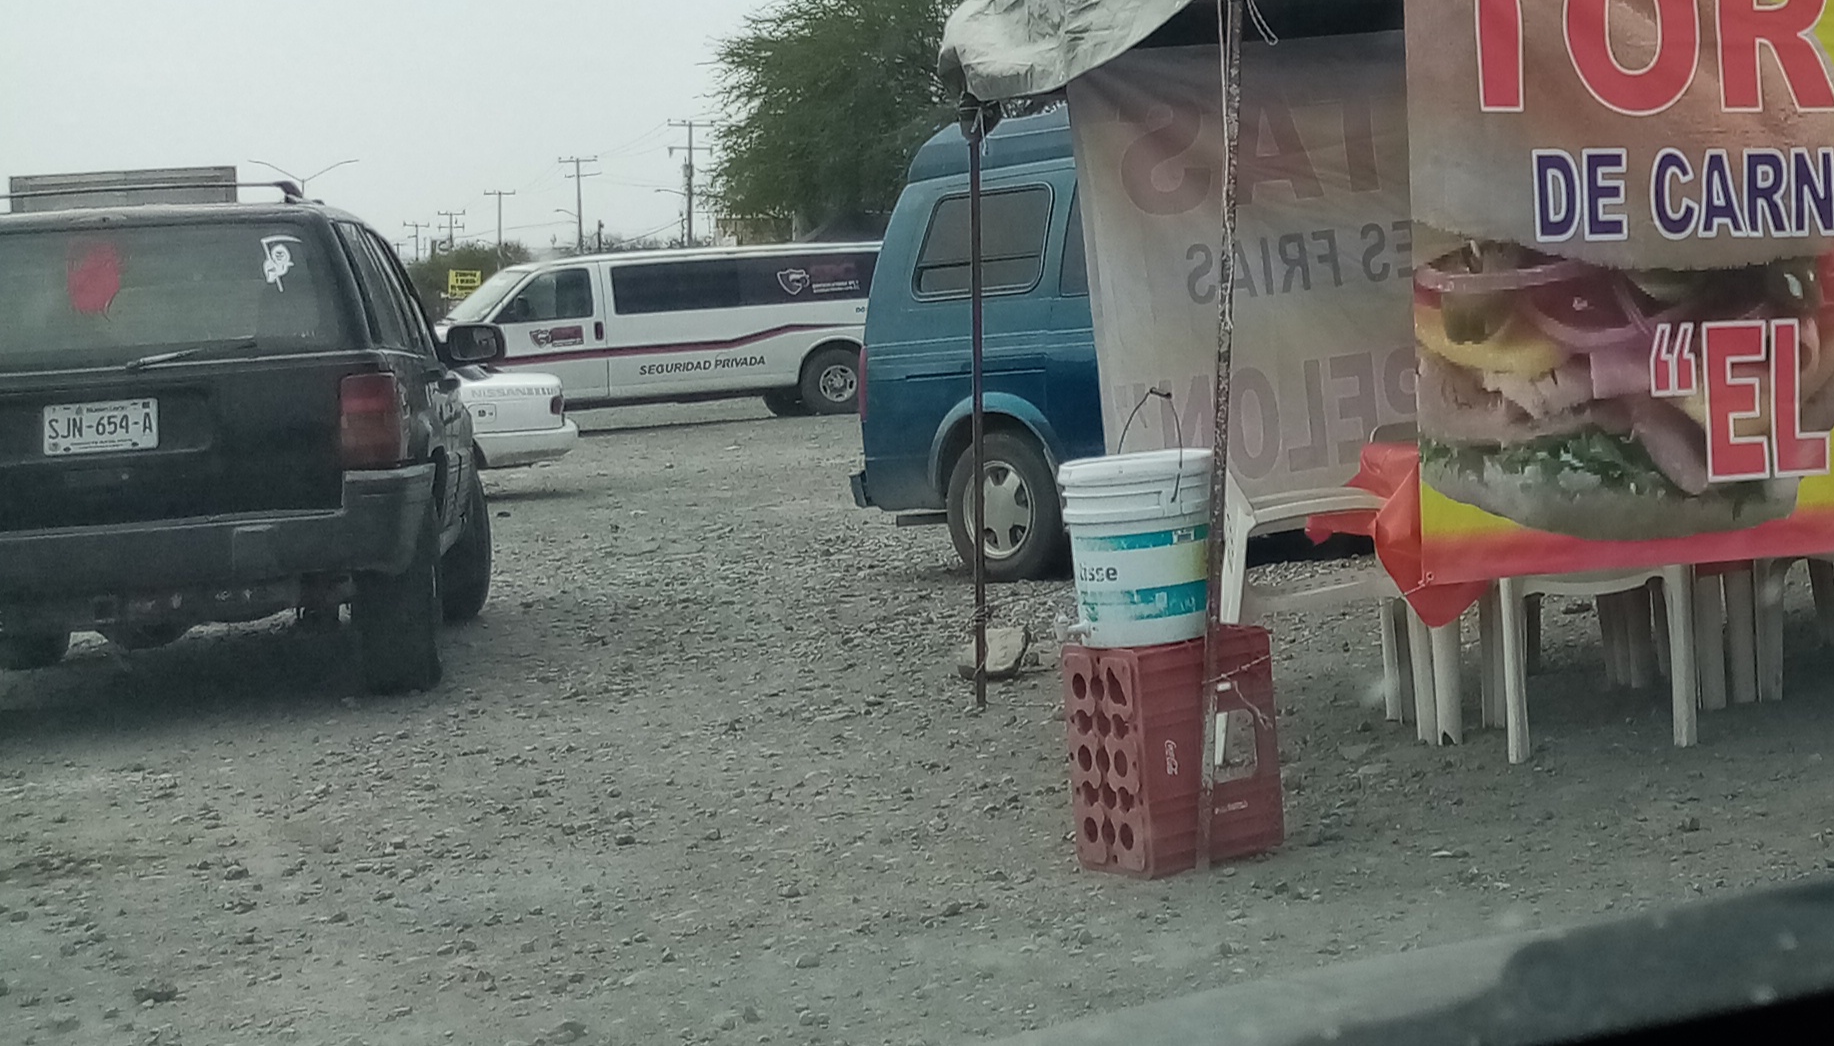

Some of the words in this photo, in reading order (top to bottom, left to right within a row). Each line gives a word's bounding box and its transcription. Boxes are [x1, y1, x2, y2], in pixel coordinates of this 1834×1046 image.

[1531, 148, 1628, 242] DE
[639, 359, 711, 375] SEGURIDAD
[714, 355, 766, 369] PRIVADA
[48, 411, 154, 440] SJN-654-A
